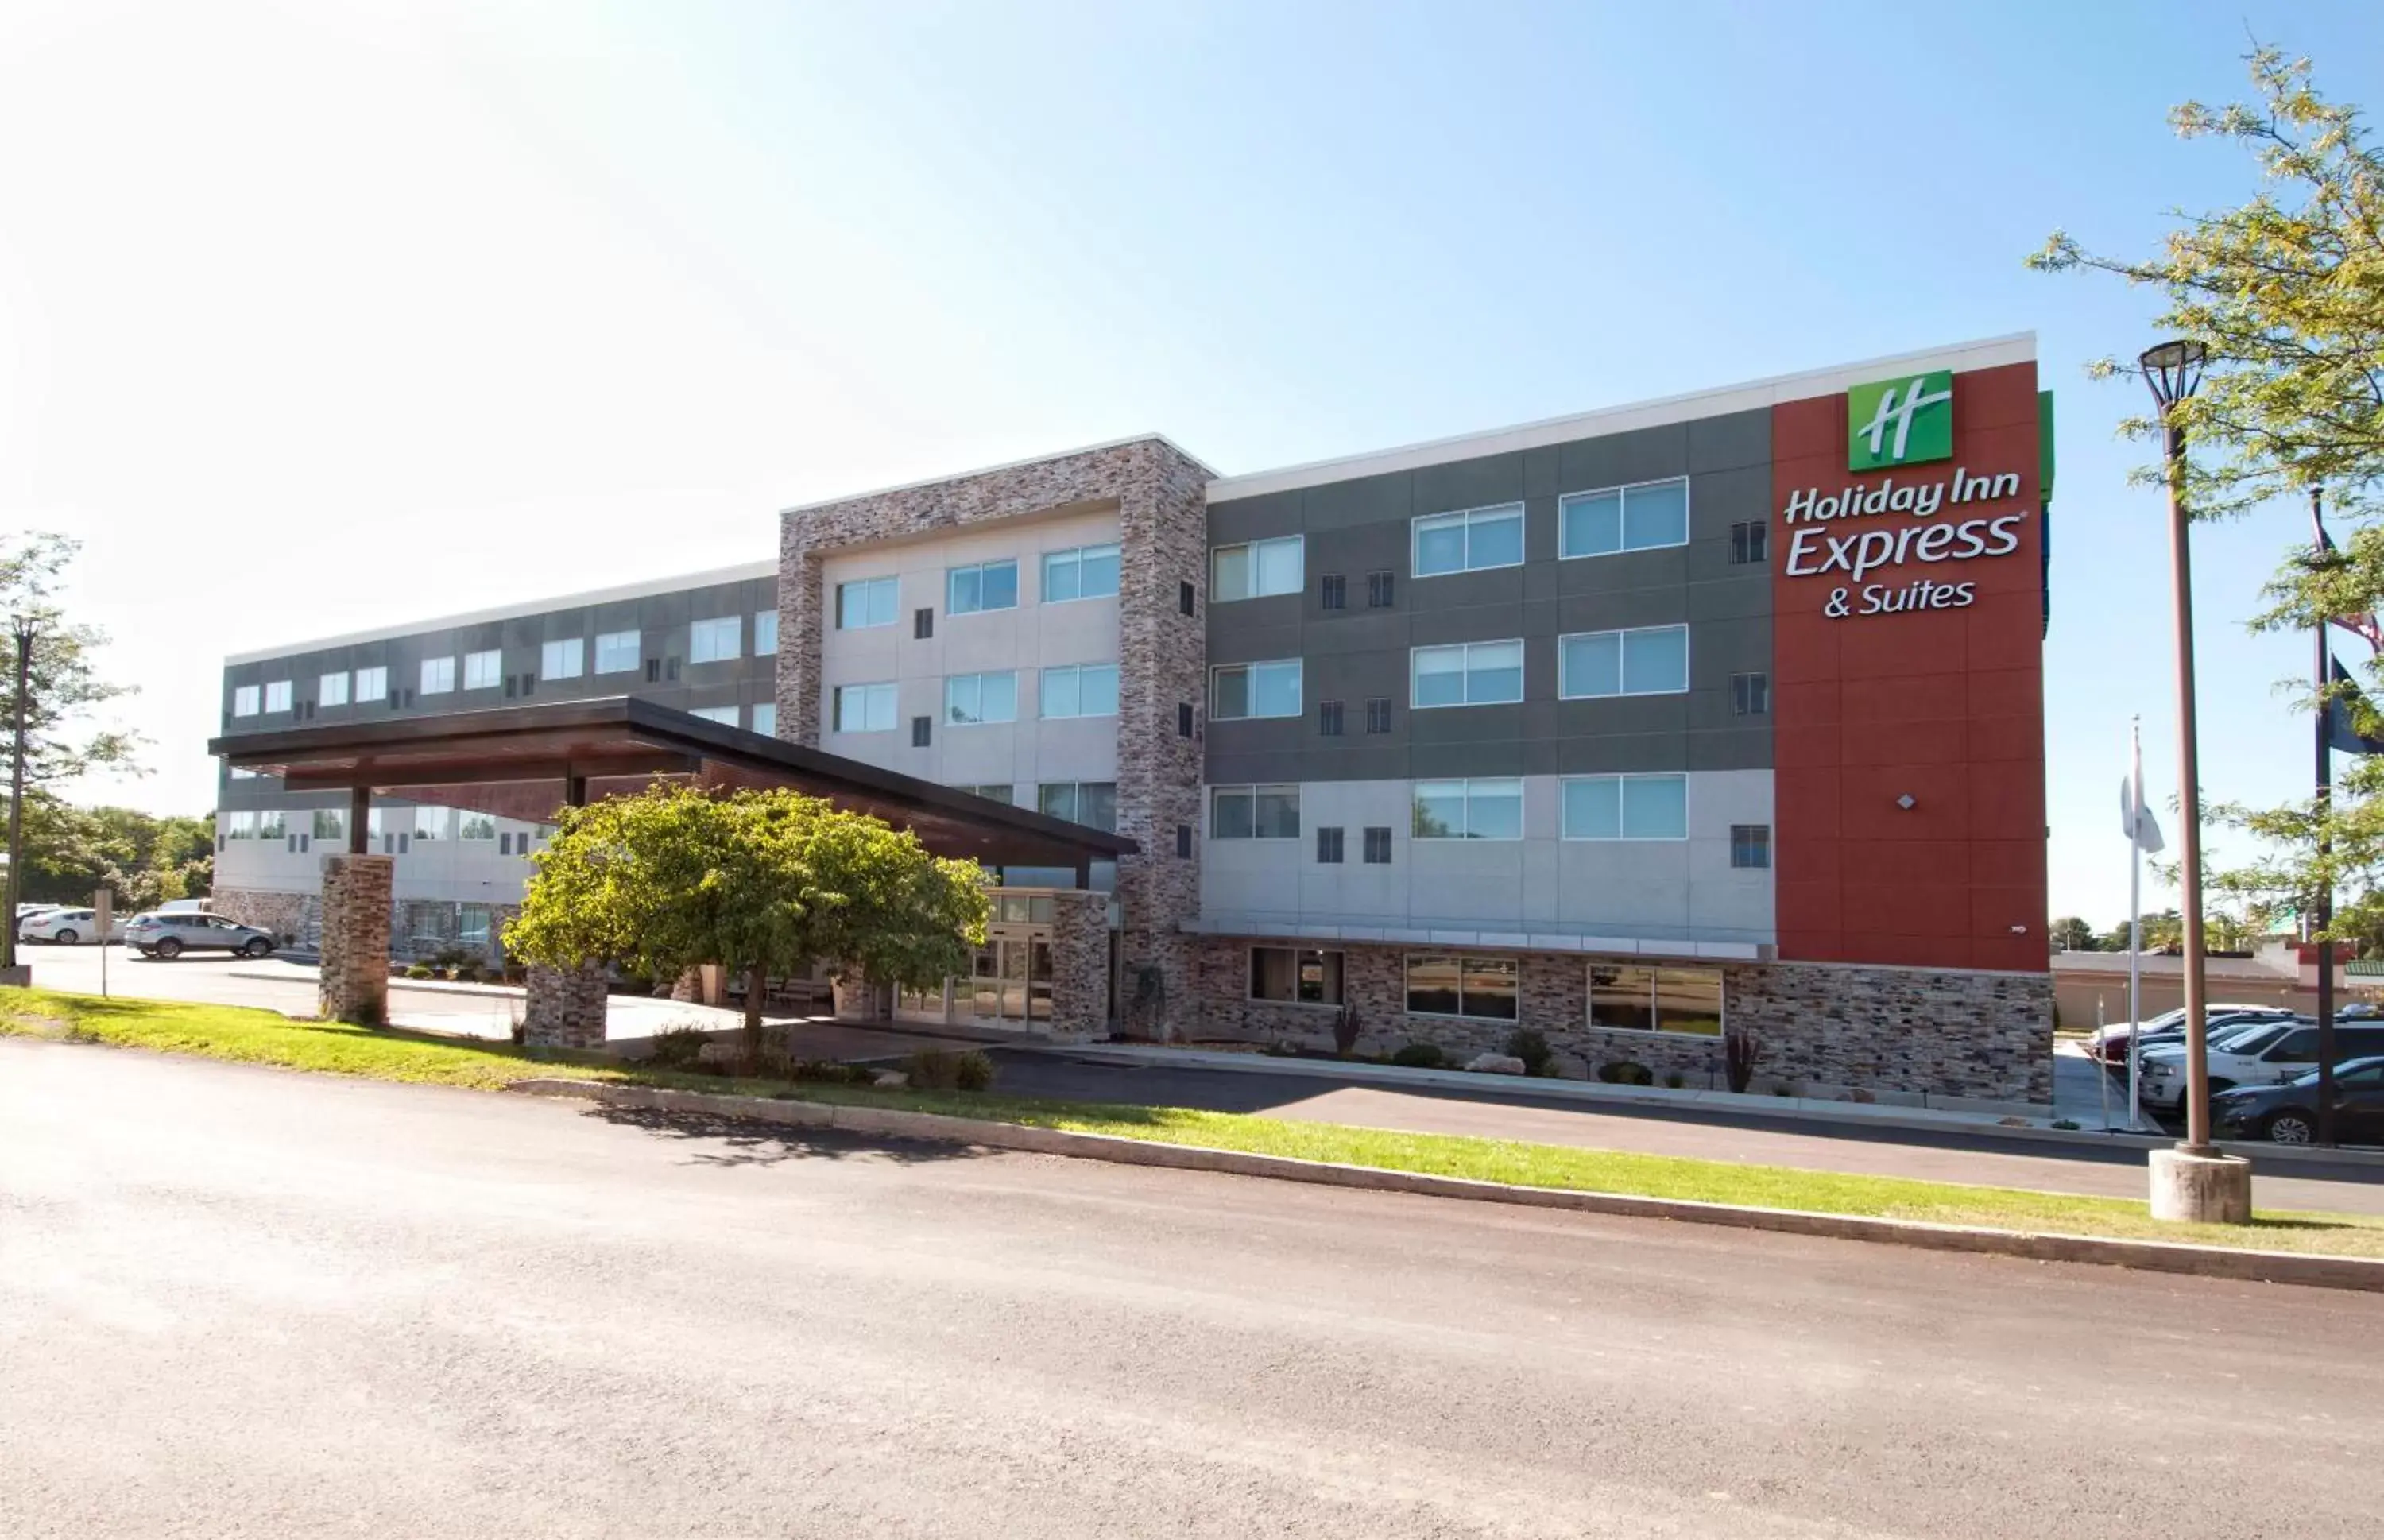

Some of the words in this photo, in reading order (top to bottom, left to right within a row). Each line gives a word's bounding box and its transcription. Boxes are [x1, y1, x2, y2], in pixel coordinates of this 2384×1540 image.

[1784, 478, 1944, 524] Holiday
[1950, 467, 2020, 503] Inn
[1786, 515, 2021, 582] Express
[1825, 588, 1849, 617] &
[1860, 580, 1975, 615] Suites
